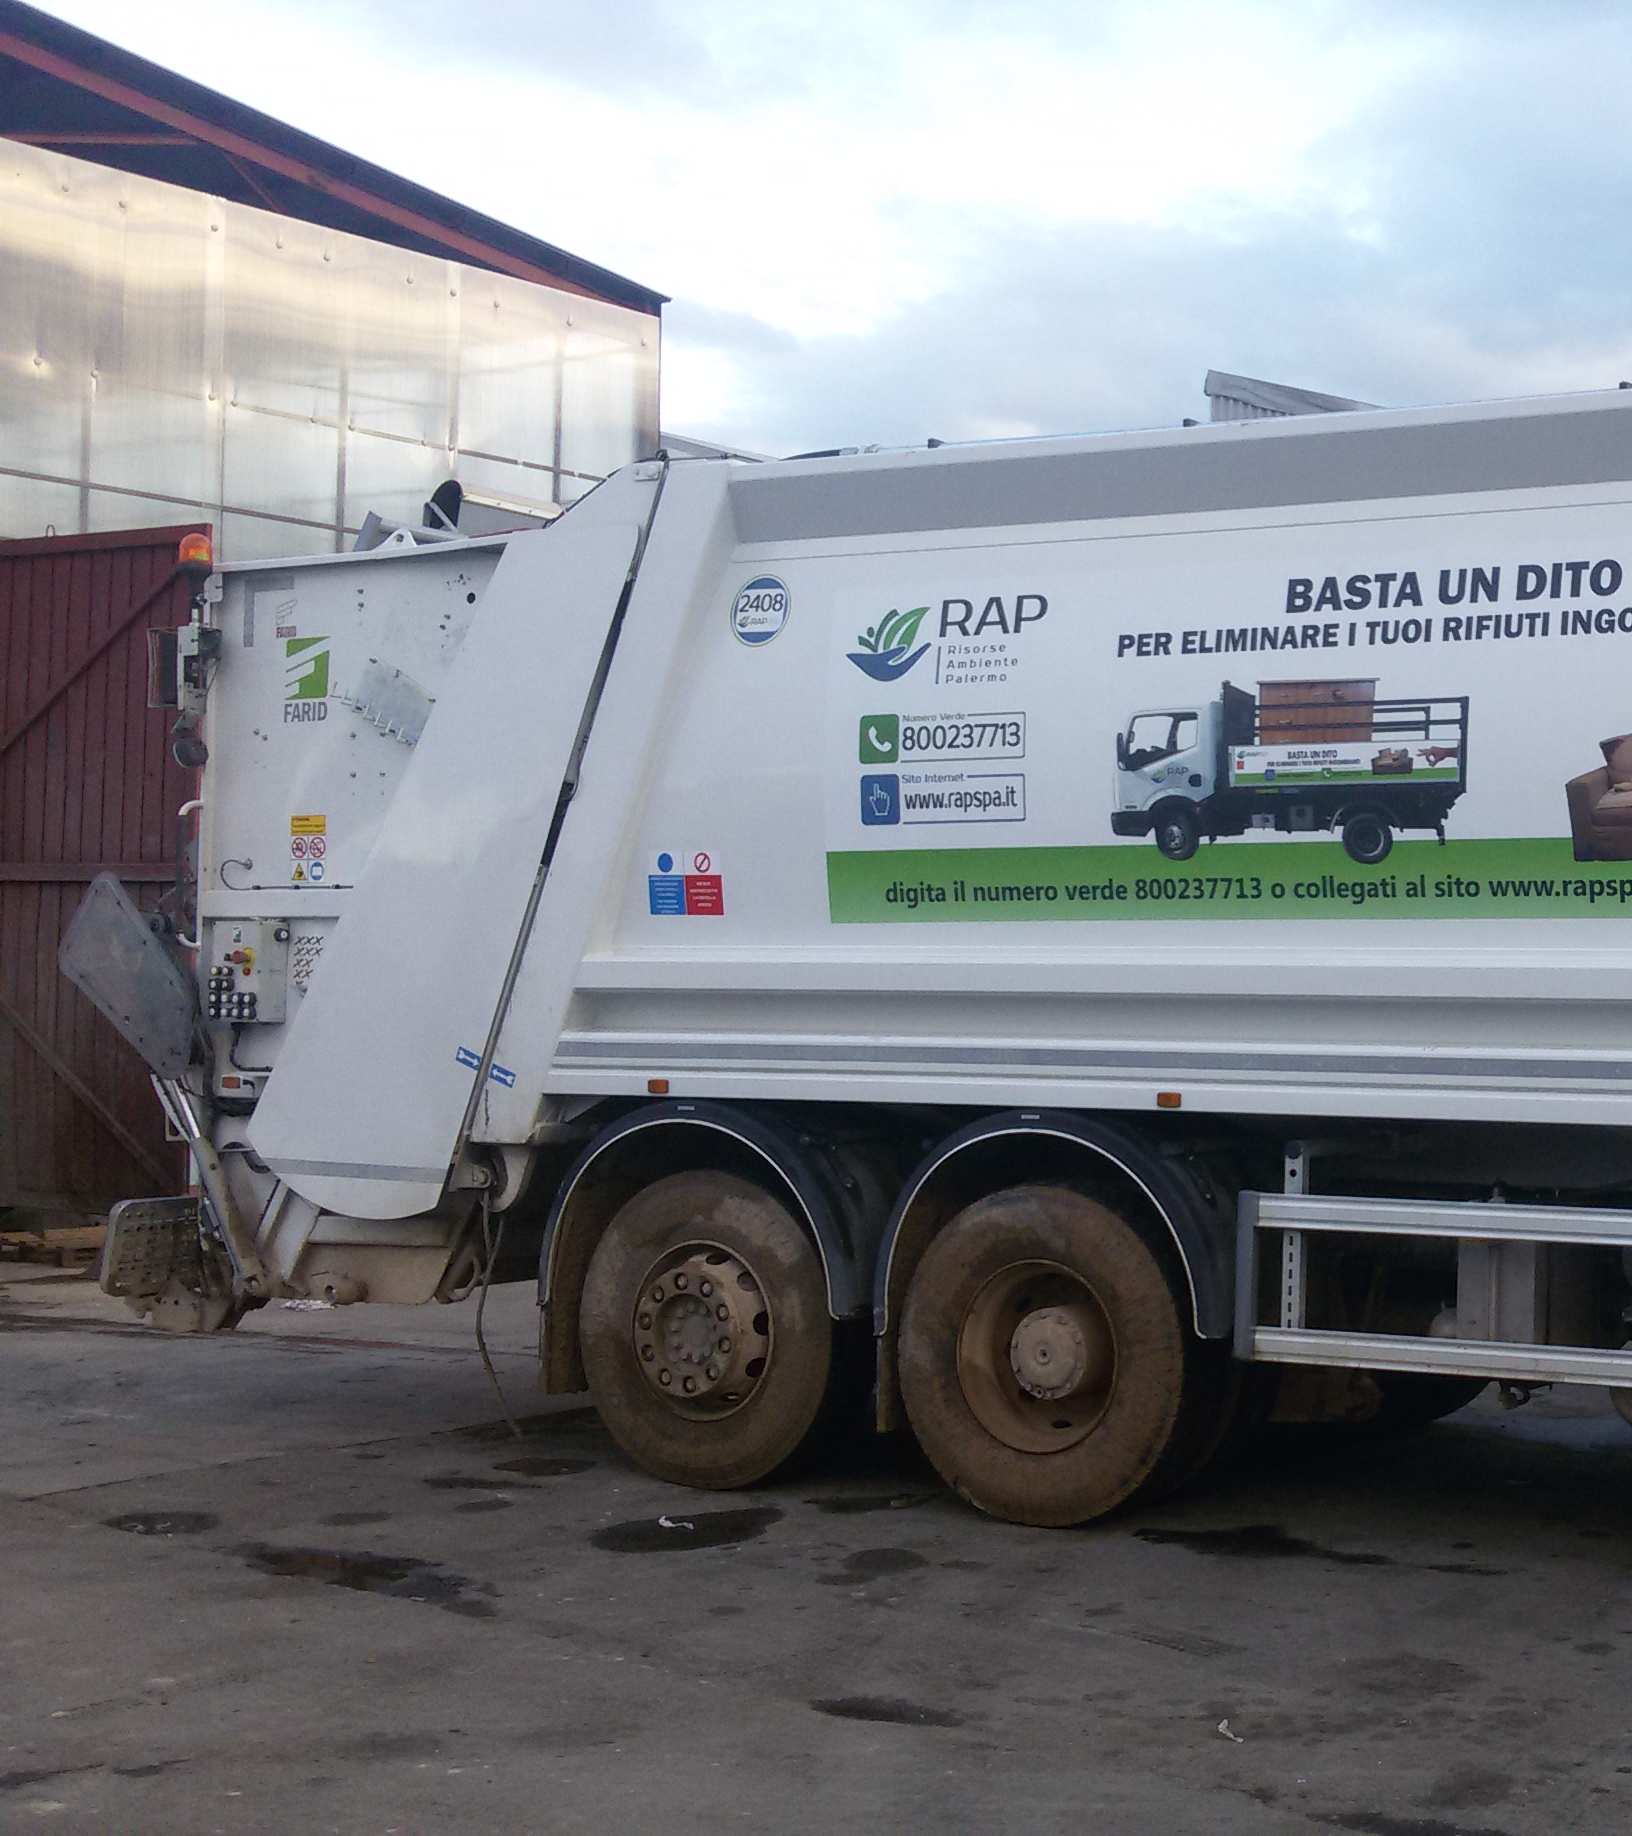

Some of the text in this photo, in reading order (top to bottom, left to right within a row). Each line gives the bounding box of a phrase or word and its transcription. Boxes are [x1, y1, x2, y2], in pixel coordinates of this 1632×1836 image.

[1286, 558, 1623, 613] BASTA UN DITO
[739, 593, 784, 612] 2408
[939, 594, 1048, 637] RAP
[1117, 632, 1173, 657] PER
[1181, 623, 1340, 654] ELIMINARE
[1348, 622, 1357, 646] I
[1366, 618, 1432, 645] TUOI
[1442, 612, 1550, 641] RIFIUTI
[948, 643, 1006, 655] Risorse
[946, 657, 1018, 669] Ambiente
[945, 673, 1007, 684] Palermo
[283, 701, 328, 723] FARID
[902, 712, 966, 723] Numero Verde
[902, 722, 1021, 751] 800237713
[1287, 750, 1308, 759] BASTA
[1322, 749, 1338, 758] DITO
[902, 772, 965, 783] Sito Internet
[904, 785, 1018, 812] www.rapspa.it
[885, 880, 947, 908] digita
[953, 880, 966, 902] il
[973, 882, 1058, 903] numero
[1065, 878, 1128, 901] verde
[1135, 877, 1262, 900] 800237713
[1271, 883, 1286, 899] o
[1293, 875, 1398, 904] collegati
[1405, 875, 1427, 898] al
[1434, 874, 1481, 898] sito
